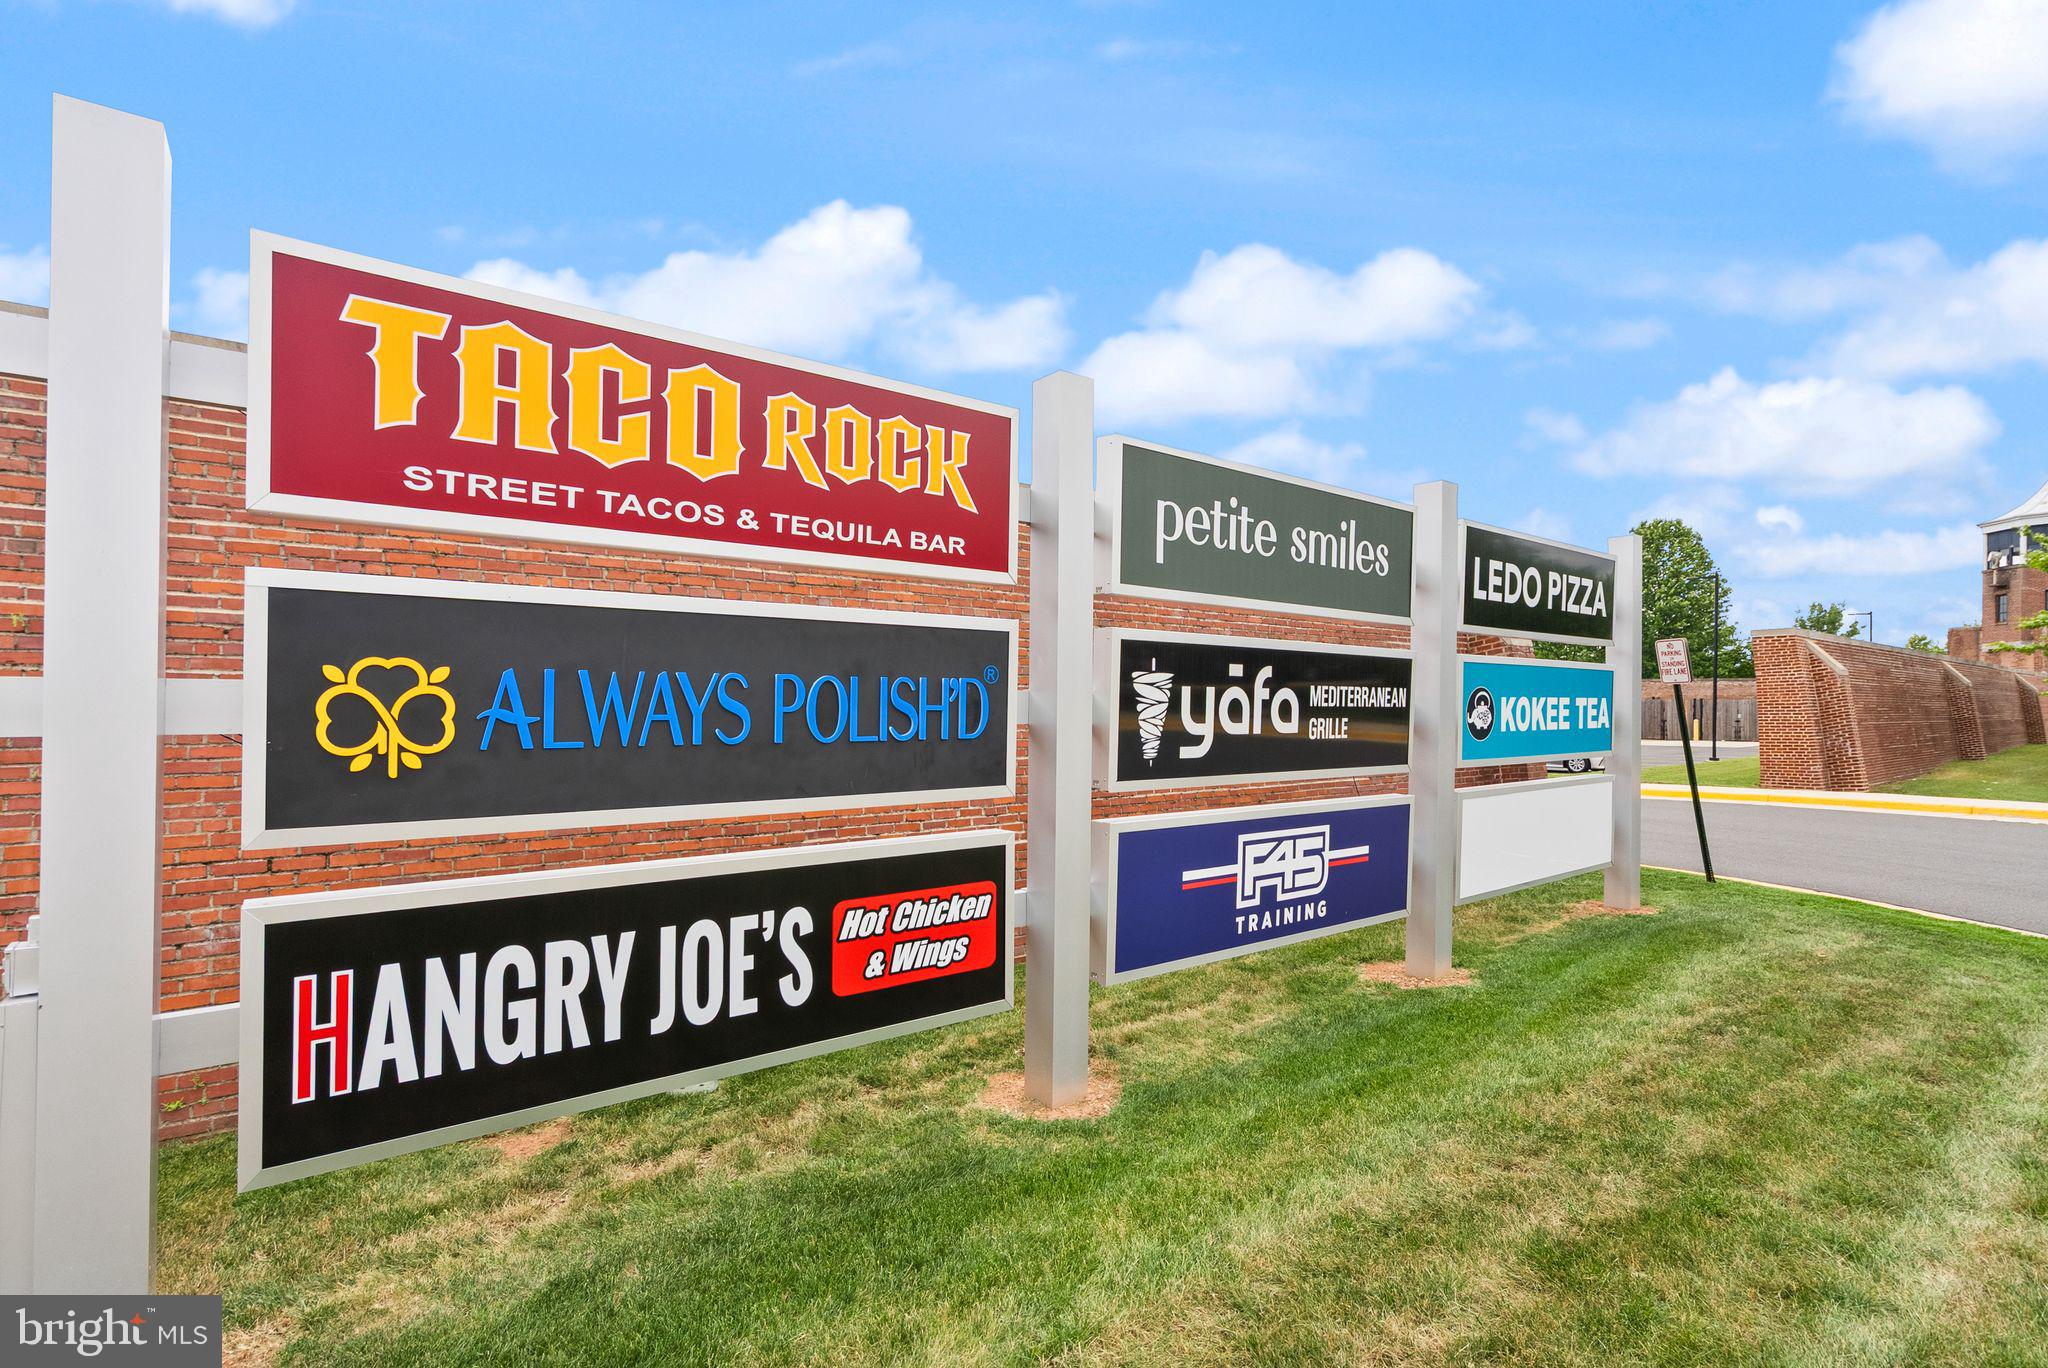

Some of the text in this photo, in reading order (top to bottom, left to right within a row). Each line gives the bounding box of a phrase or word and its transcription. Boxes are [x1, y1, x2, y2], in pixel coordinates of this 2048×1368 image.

[339, 293, 979, 514] TACO ROCK
[402, 465, 966, 556] STREET TACOS & TEQUILA BAR
[1156, 496, 1389, 577] petite smiles
[1473, 556, 1608, 618] LEDO PIZZA
[1662, 660, 1686, 668] STANDING
[1673, 668, 1687, 676] LANE
[476, 667, 751, 751] ALWAYS
[1309, 685, 1407, 708] MEDITERRANEAN
[1500, 696, 1610, 733] KOKEE TEA
[1308, 717, 1348, 740] GRILLE
[1242, 835, 1325, 898] F45
[838, 890, 993, 942] Hot Chicken
[1235, 900, 1328, 935] TRAINING
[864, 935, 971, 979] & Wings
[292, 906, 814, 1104] HANGRY JOE'S
